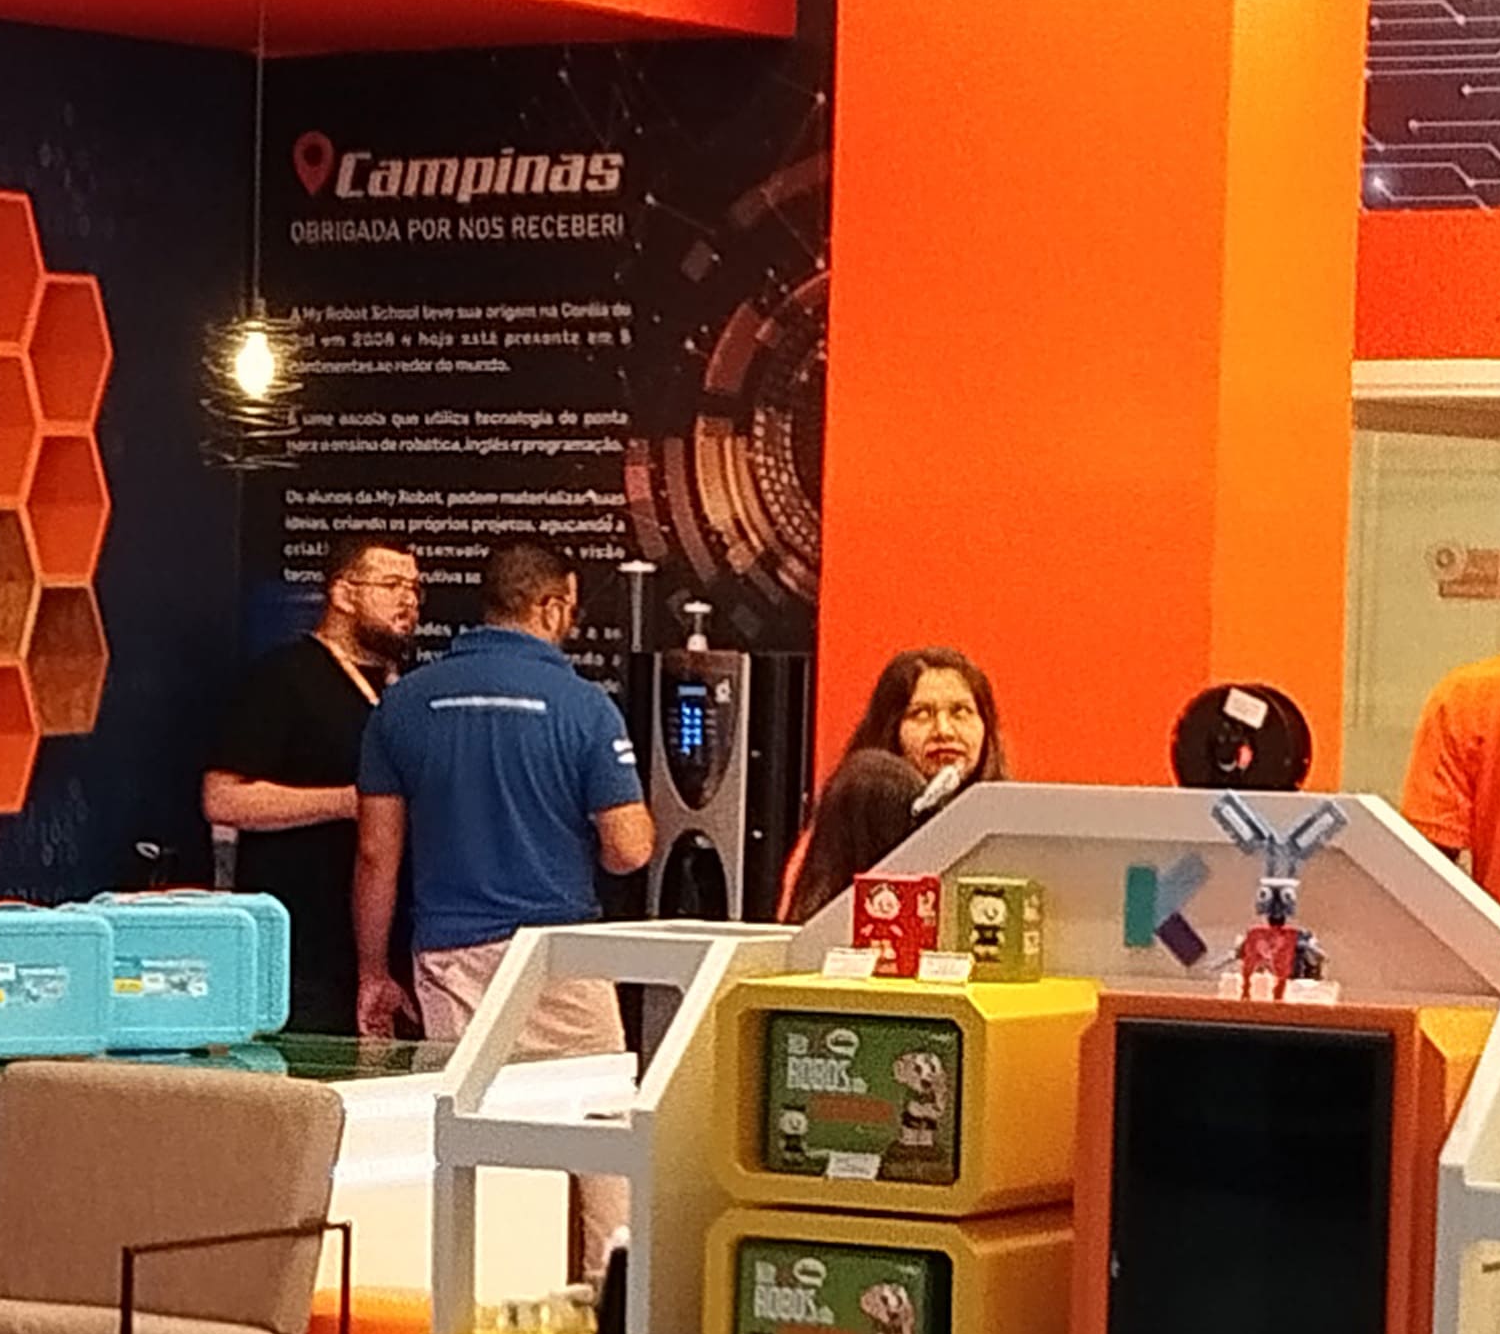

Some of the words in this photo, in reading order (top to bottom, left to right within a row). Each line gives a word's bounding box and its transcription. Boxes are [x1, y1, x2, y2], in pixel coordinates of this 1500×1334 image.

[336, 147, 624, 203] Campinas
[290, 218, 401, 244] OBRIGADA
[407, 219, 451, 241] POR
[458, 216, 505, 240] NOS
